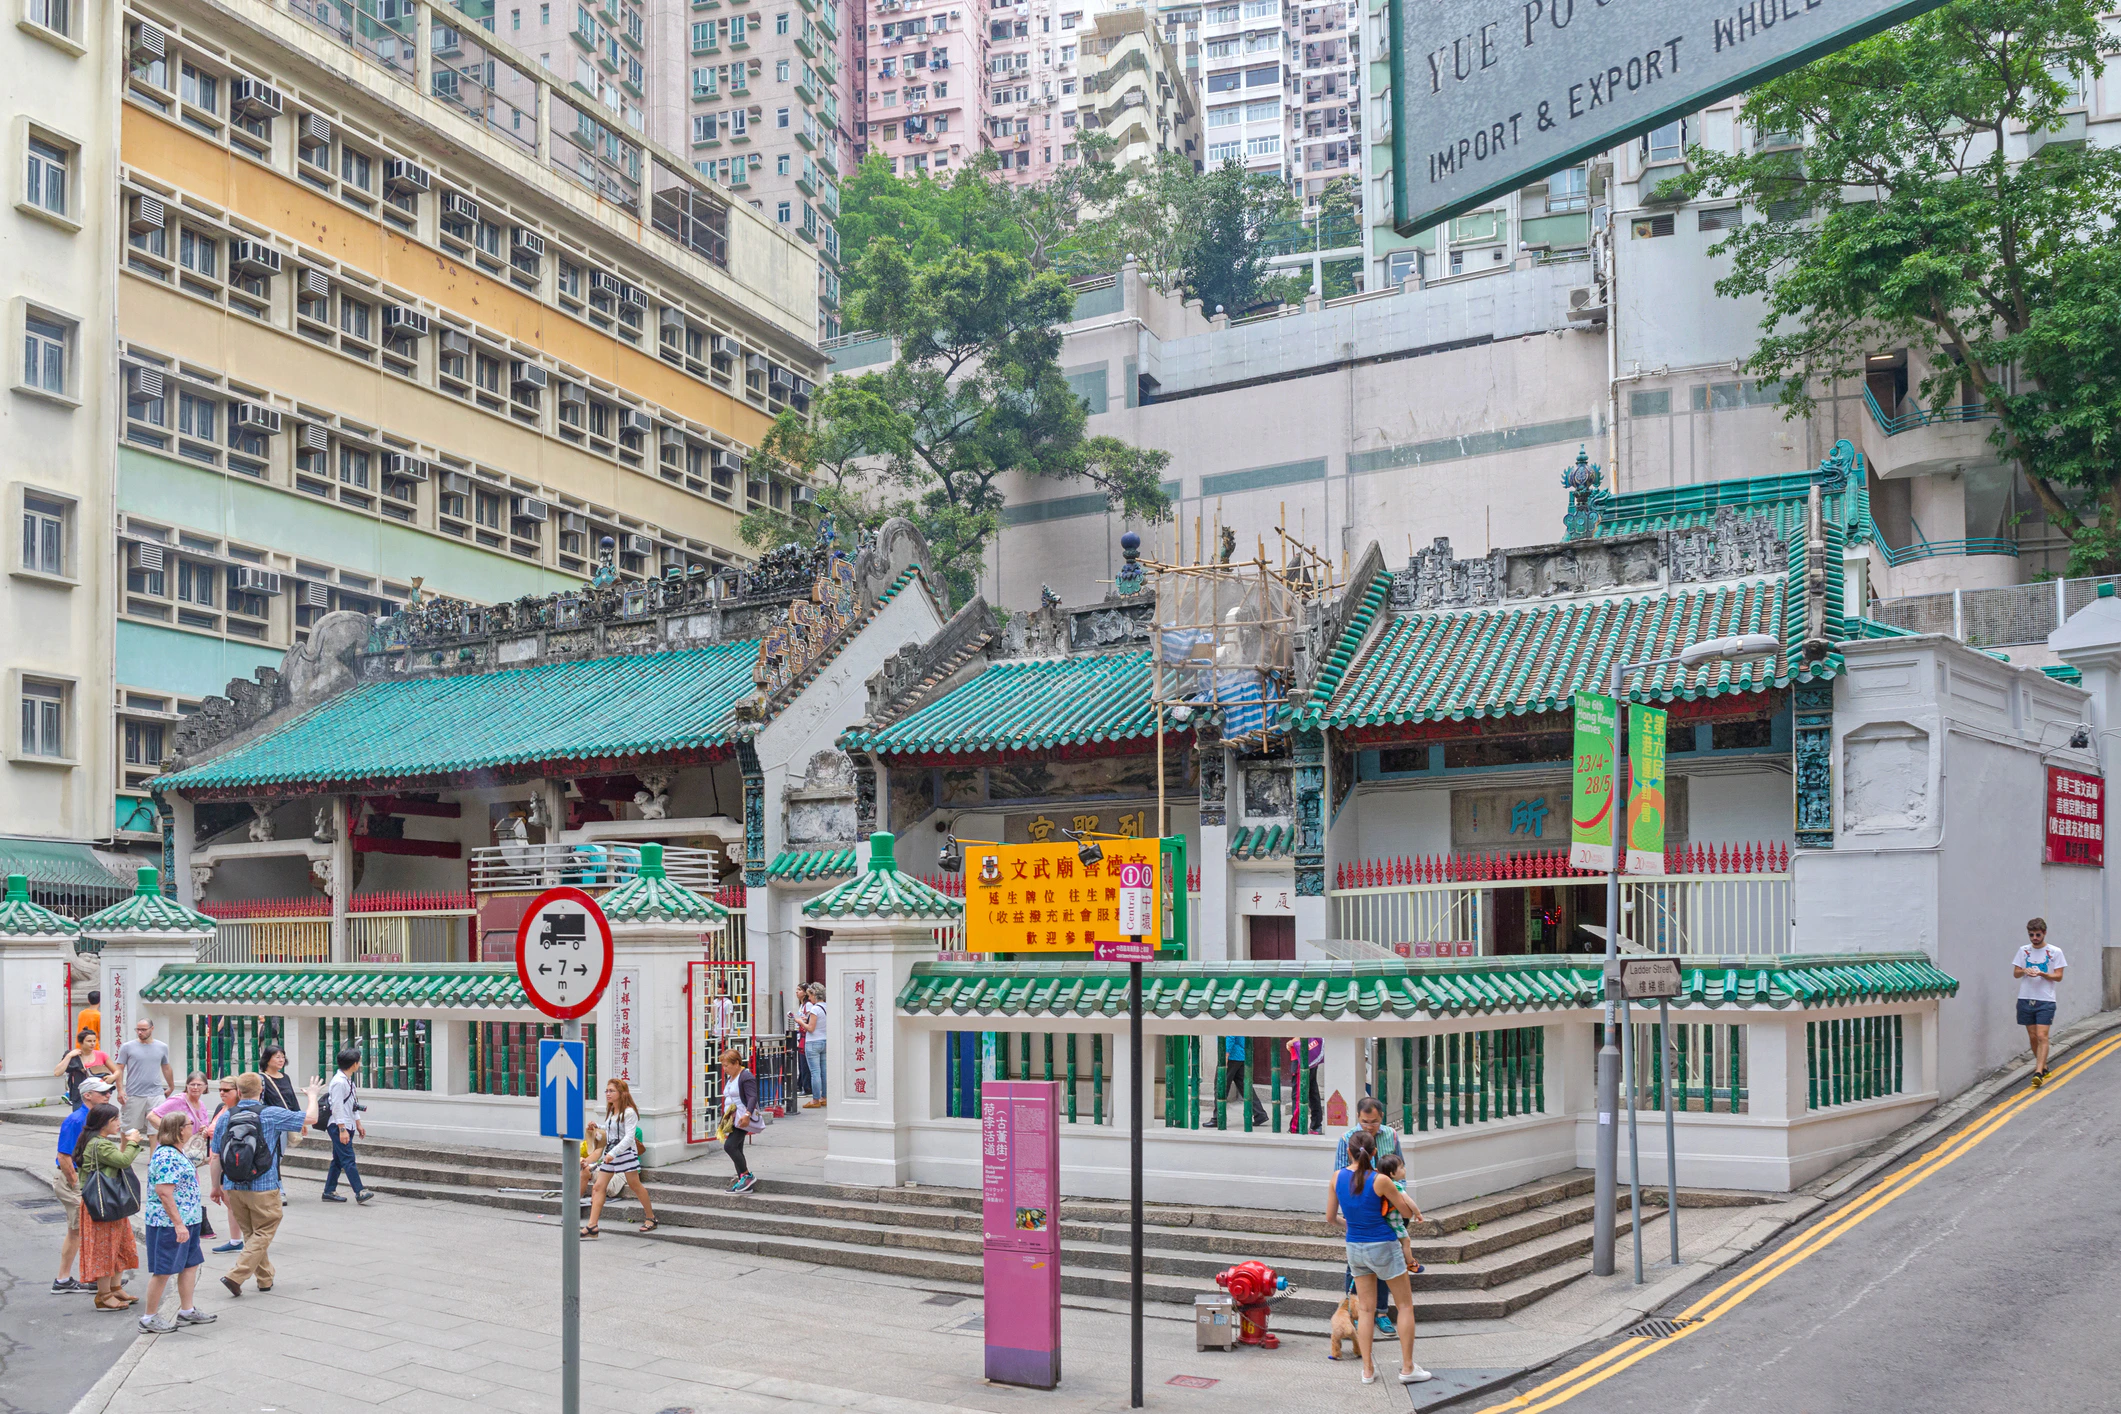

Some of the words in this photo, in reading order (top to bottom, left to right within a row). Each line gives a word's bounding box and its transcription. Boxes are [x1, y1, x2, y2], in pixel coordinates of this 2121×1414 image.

[1427, 21, 1498, 95] YUE
[1430, 112, 1522, 183] IMPORT
[1537, 100, 1557, 132] &
[1569, 36, 1683, 119] EXPORT
[1714, 0, 1821, 52] WHOL
[1578, 696, 1590, 709] The
[1592, 700, 1604, 712] 6th
[1576, 720, 1601, 735] Games
[1577, 708, 1596, 724] Hong
[1598, 713, 1614, 728] Kong
[1577, 753, 1610, 774] 23/4-
[1585, 774, 1611, 795] 28/5
[1509, 797, 1549, 837] 所
[988, 890, 1055, 906] 延生牌位
[1069, 887, 1116, 903] 往生牌
[1127, 892, 1135, 931] Central
[1142, 892, 1152, 930] 中環
[558, 960, 567, 976] 7
[1630, 965, 1652, 975] Ladder
[1653, 963, 1673, 974] Street
[557, 980, 568, 990] m
[983, 1103, 996, 1157] 荷李活道
[996, 1110, 1008, 1162] (古董街)
